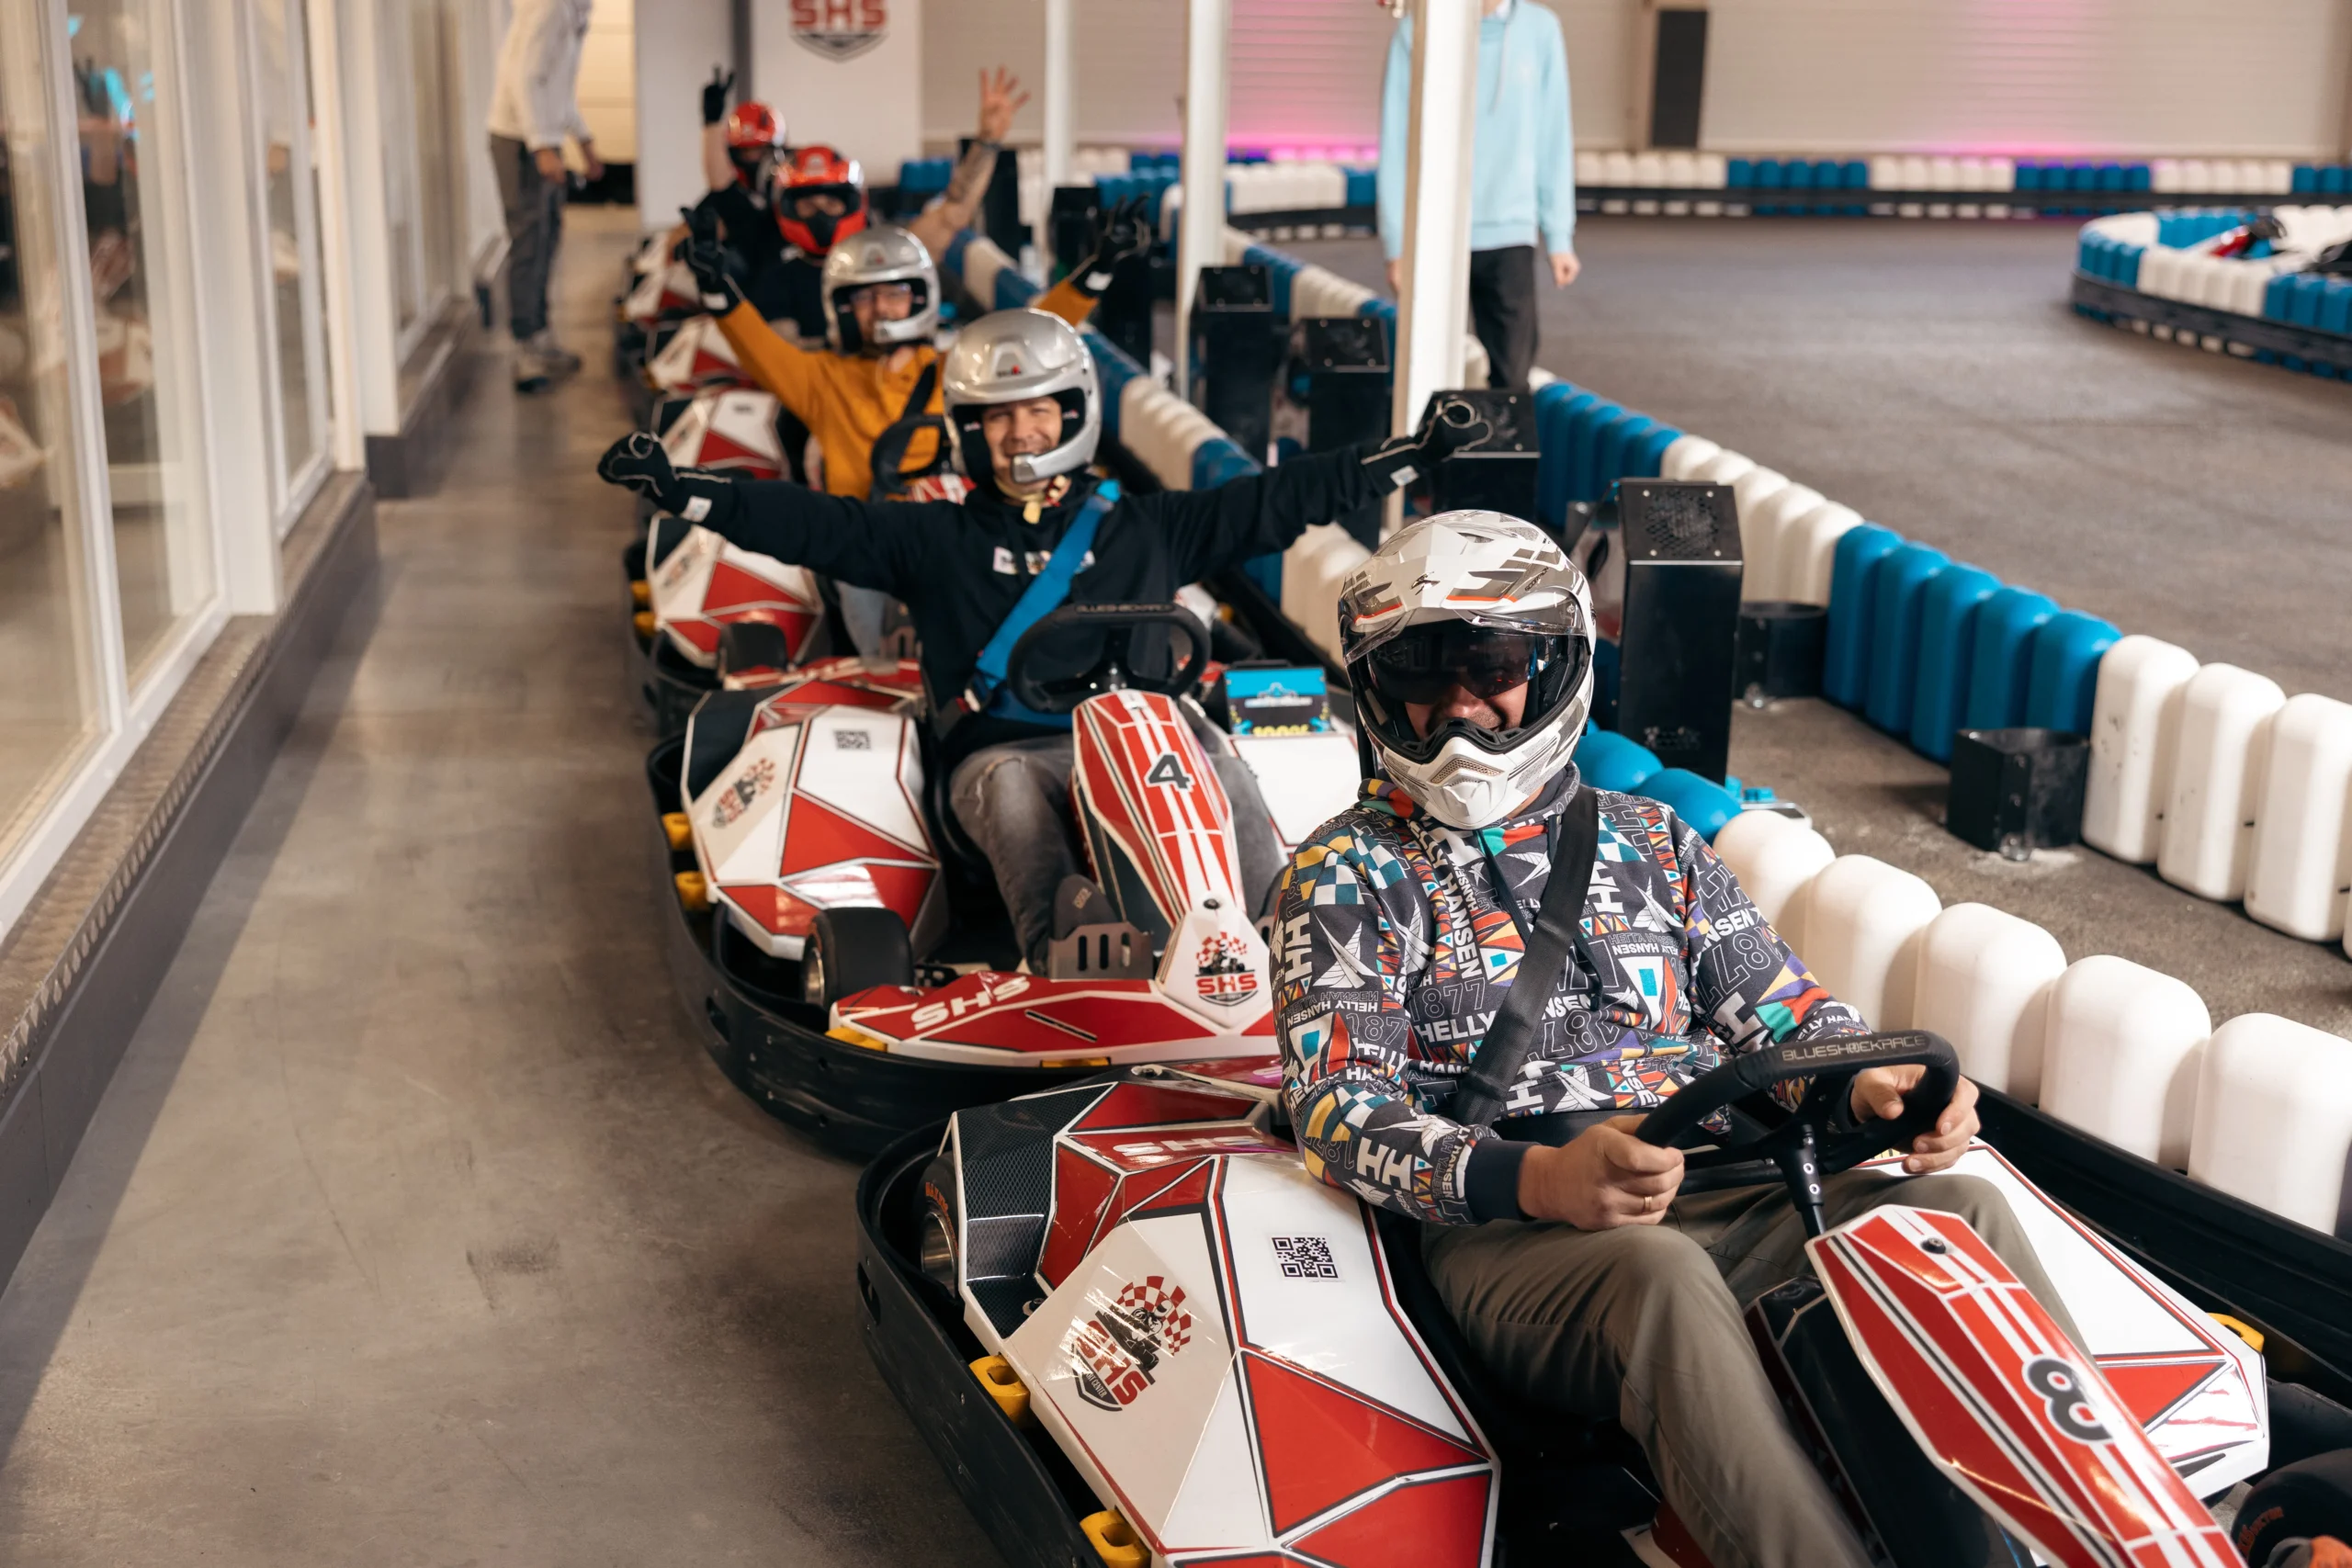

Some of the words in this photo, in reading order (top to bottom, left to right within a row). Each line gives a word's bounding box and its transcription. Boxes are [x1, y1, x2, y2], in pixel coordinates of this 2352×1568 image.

[789, 0, 888, 29] SHS
[1147, 753, 1192, 790] 4
[1438, 873, 1483, 978] HANSEN
[1284, 912, 1313, 984] HH
[1612, 942, 1660, 957] HANSEN
[1196, 973, 1258, 995] SHS
[1408, 976, 1486, 1022] 1877
[911, 976, 1031, 1031] SHS
[1286, 999, 1331, 1029] HANSEN
[1334, 999, 1378, 1013] HELLY
[1414, 1010, 1498, 1043] HELLY
[1114, 1134, 1263, 1157] SHS
[1356, 1136, 1412, 1191] HH
[1442, 1145, 1463, 1200] HANSEN
[1076, 1320, 1148, 1405] SHS
[1091, 1377, 1108, 1398] CENTER
[2027, 1358, 2115, 1442] 8
